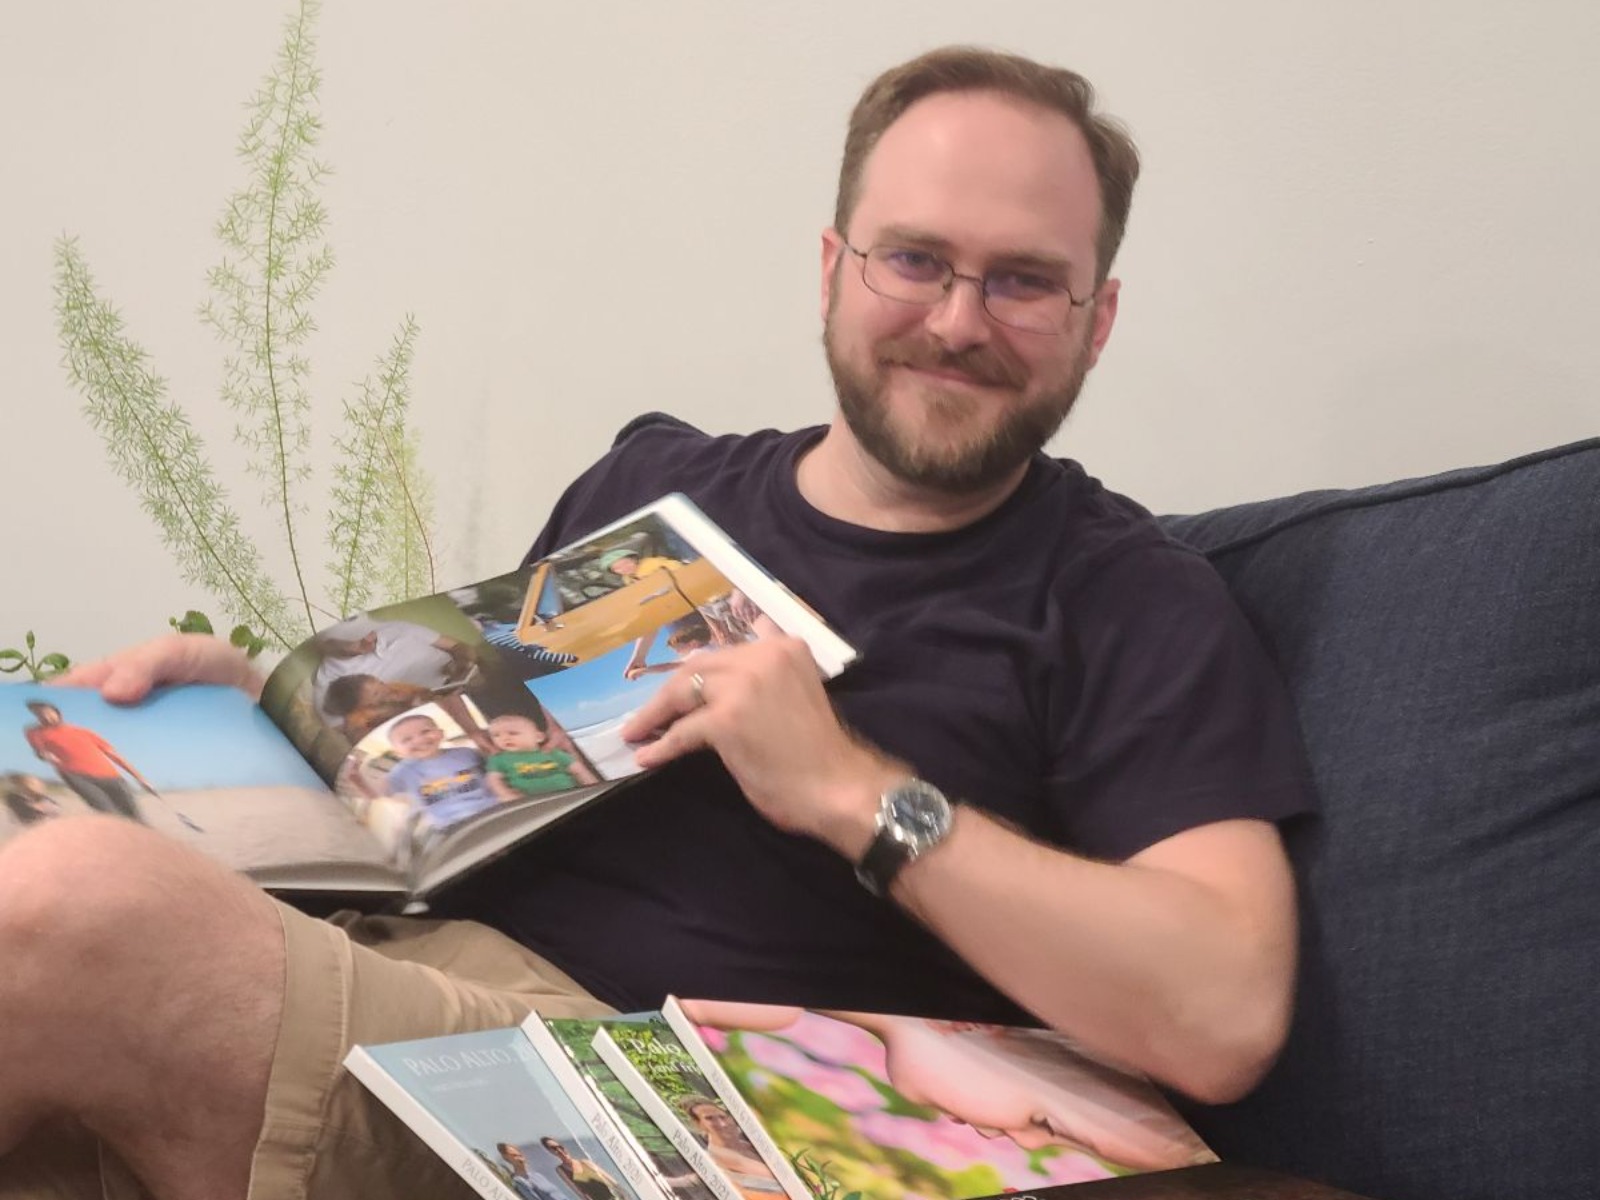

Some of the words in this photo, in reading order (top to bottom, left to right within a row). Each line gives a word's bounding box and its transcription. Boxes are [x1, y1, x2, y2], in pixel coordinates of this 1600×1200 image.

[626, 1037, 681, 1056] Palo
[402, 1053, 461, 1077] PALO
[673, 1129, 690, 1154] Palo
[462, 1158, 489, 1188] PALO
